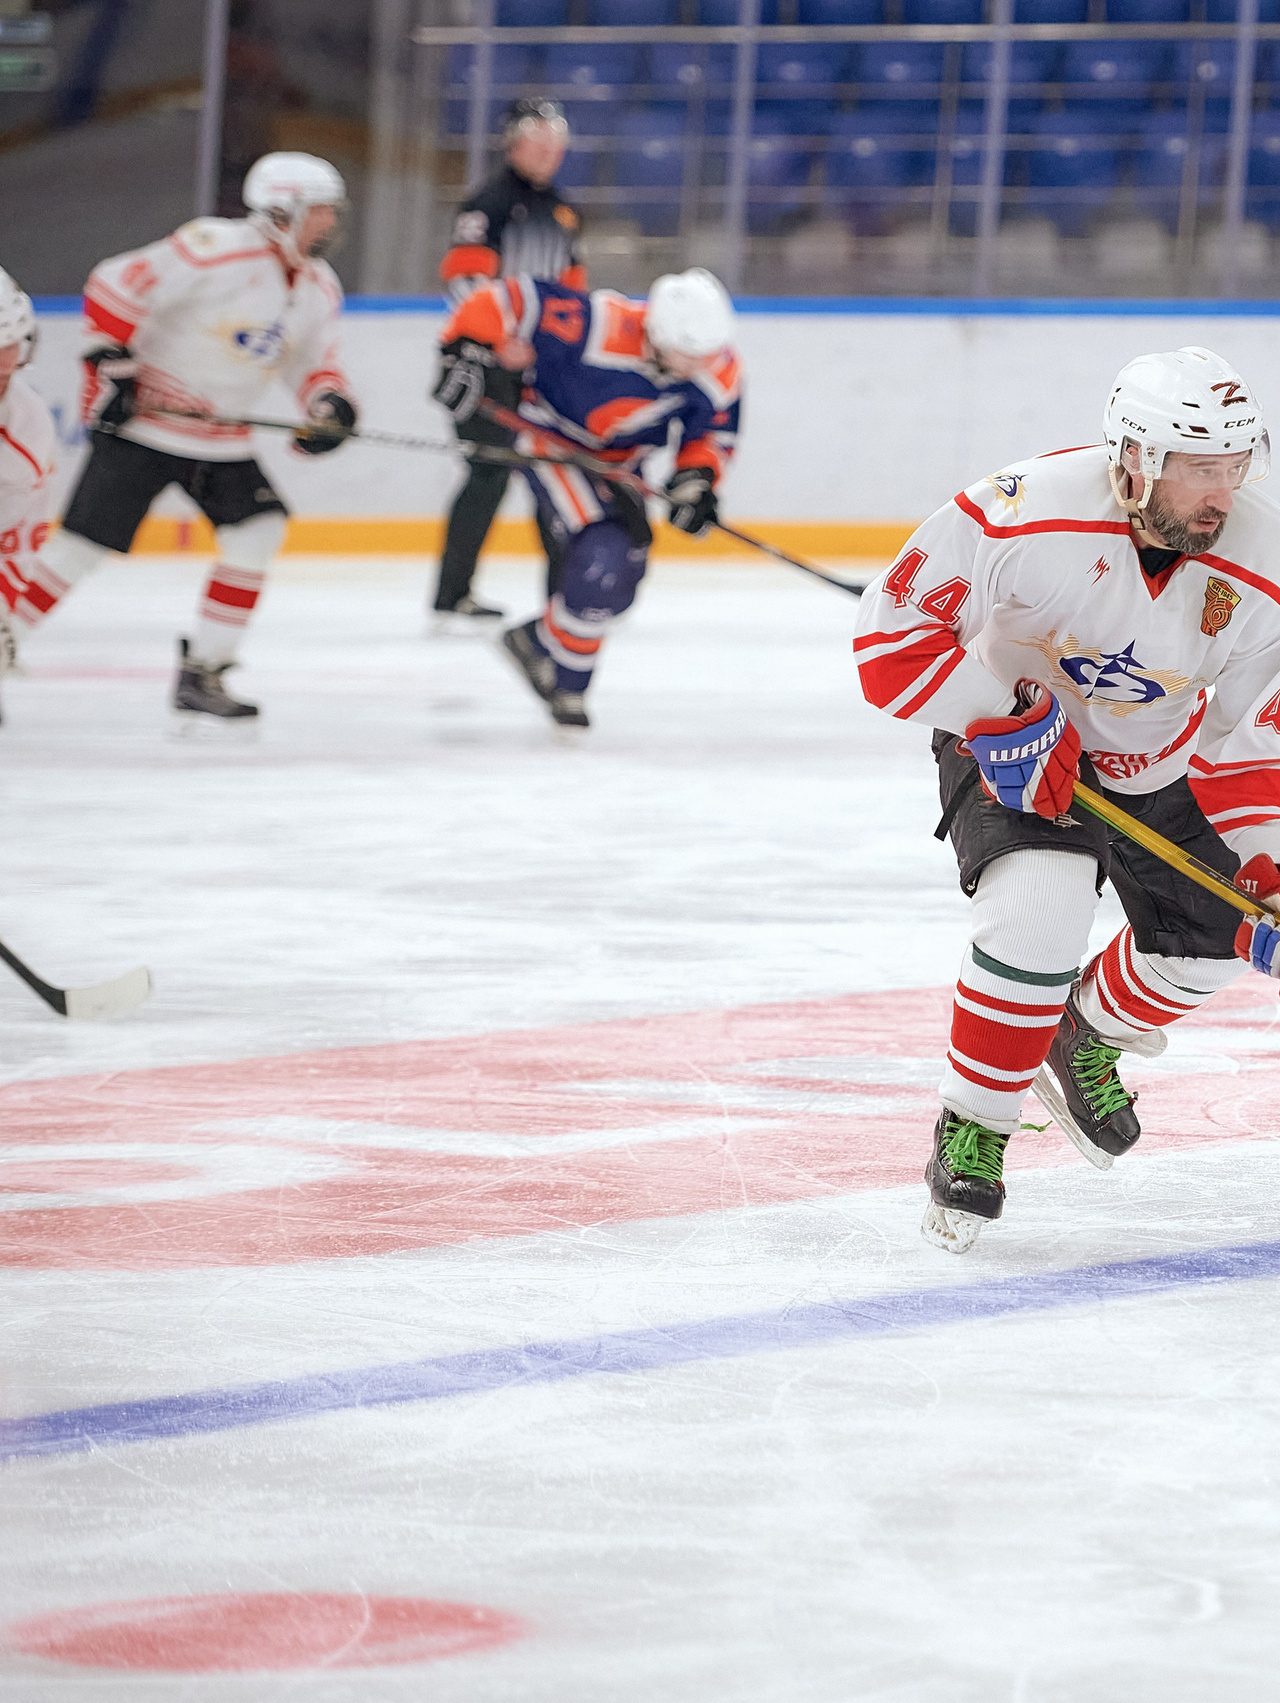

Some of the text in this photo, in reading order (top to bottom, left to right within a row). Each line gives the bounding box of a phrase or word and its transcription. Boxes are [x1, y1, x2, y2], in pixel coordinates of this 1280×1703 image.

[1121, 416, 1147, 434] CCM
[1223, 416, 1256, 429] CCM
[882, 547, 971, 626] 44
[989, 704, 1067, 763] WARR
